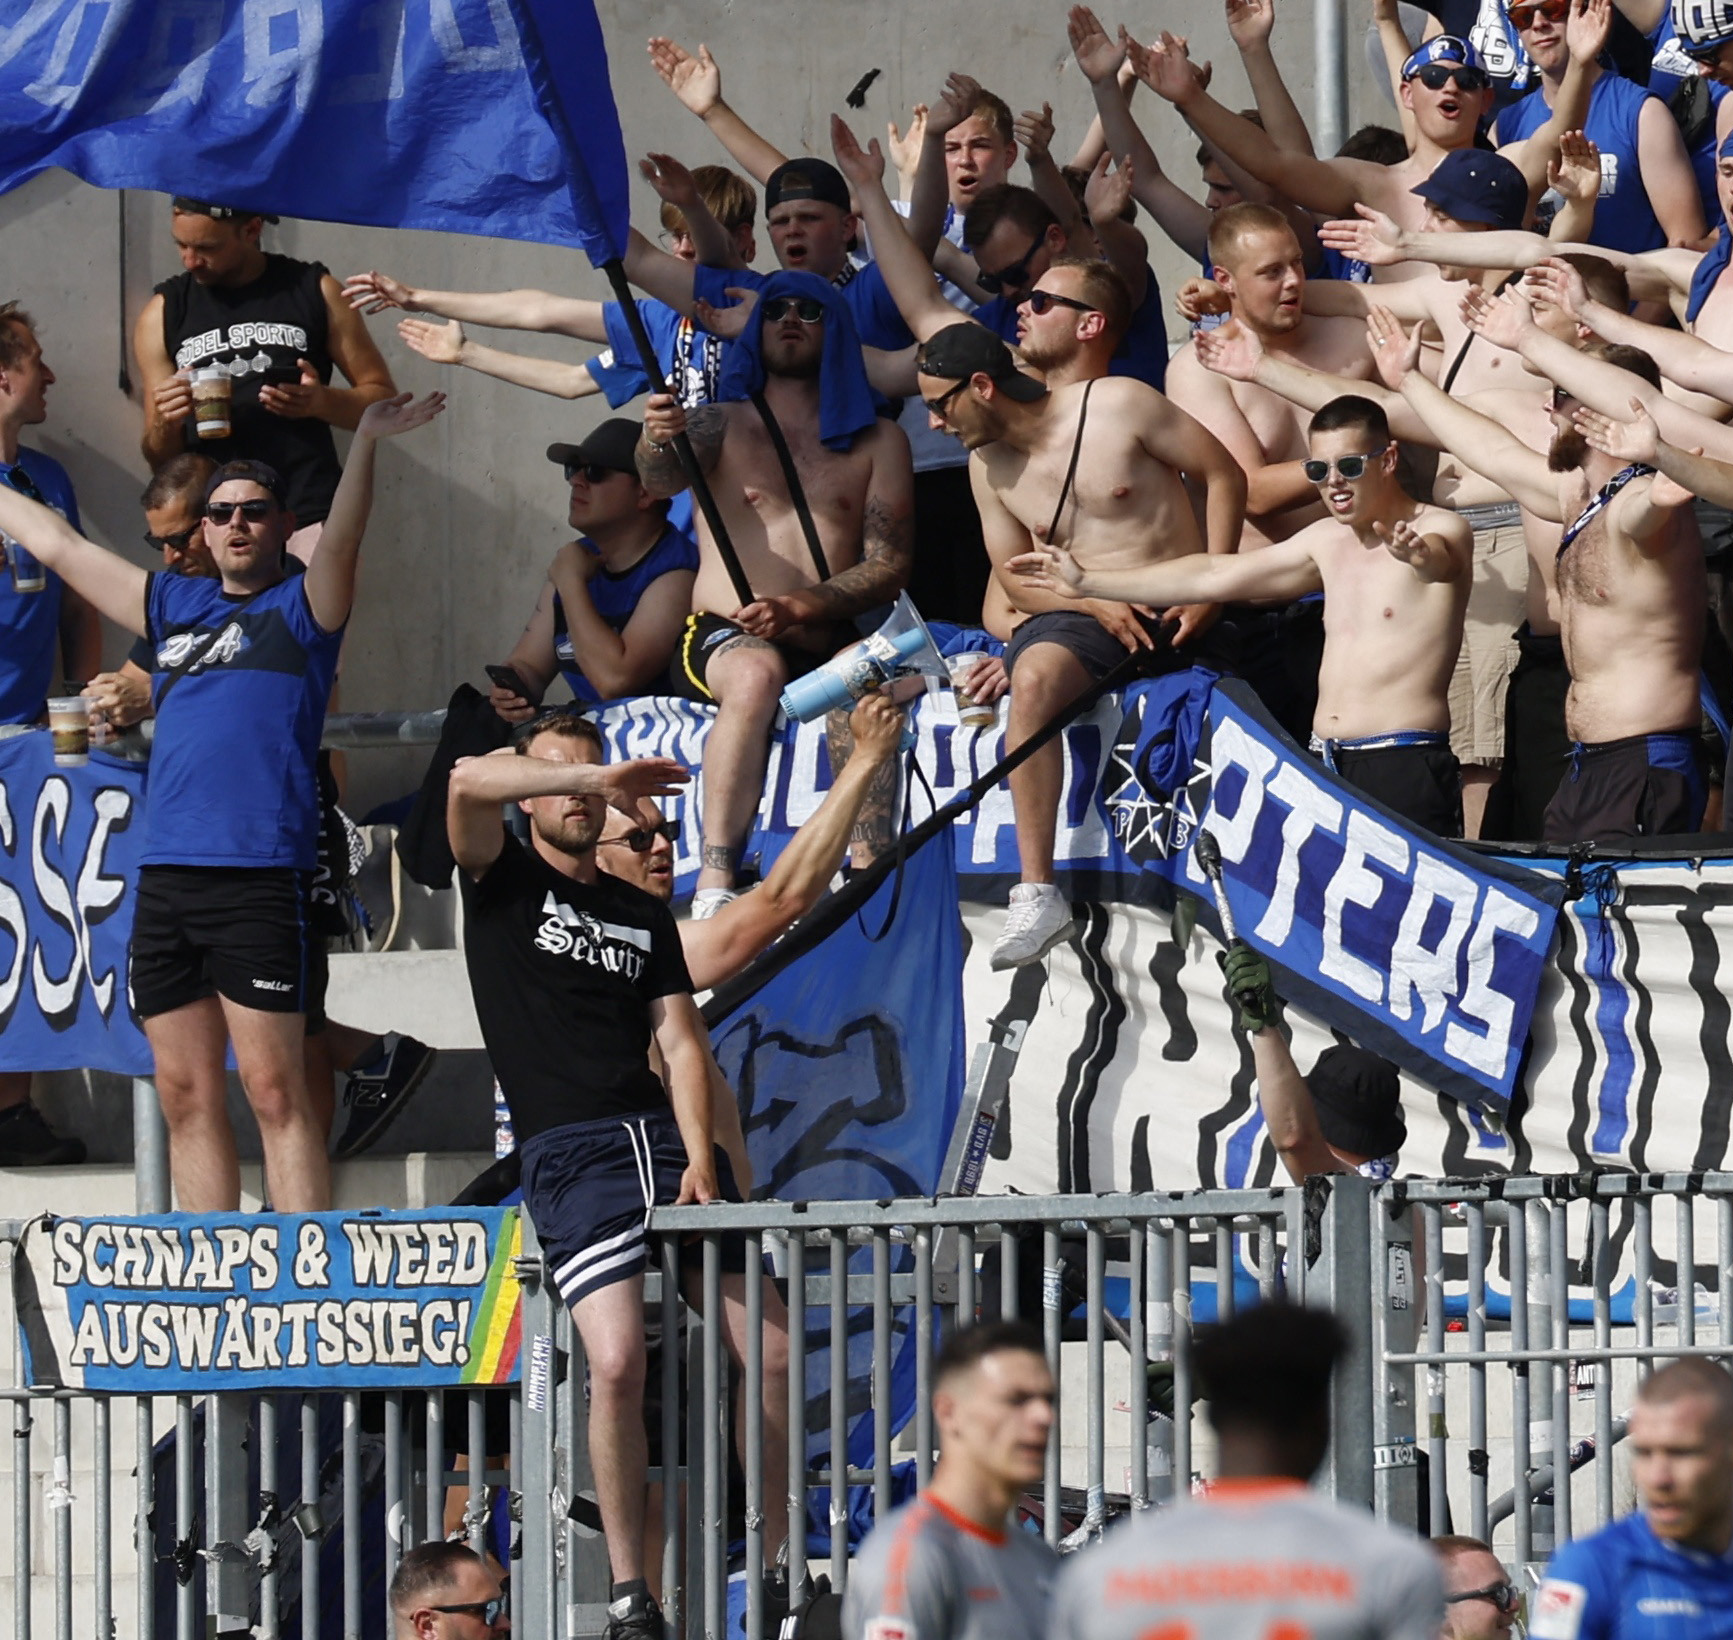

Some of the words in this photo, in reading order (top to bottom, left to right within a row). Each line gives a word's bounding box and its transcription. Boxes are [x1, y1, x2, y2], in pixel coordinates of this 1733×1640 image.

[54, 1220, 280, 1290] SCHNAPS
[294, 1221, 331, 1288] &
[343, 1221, 489, 1286] WEED
[69, 1296, 471, 1369] AUSWÄRTSSIEG!
